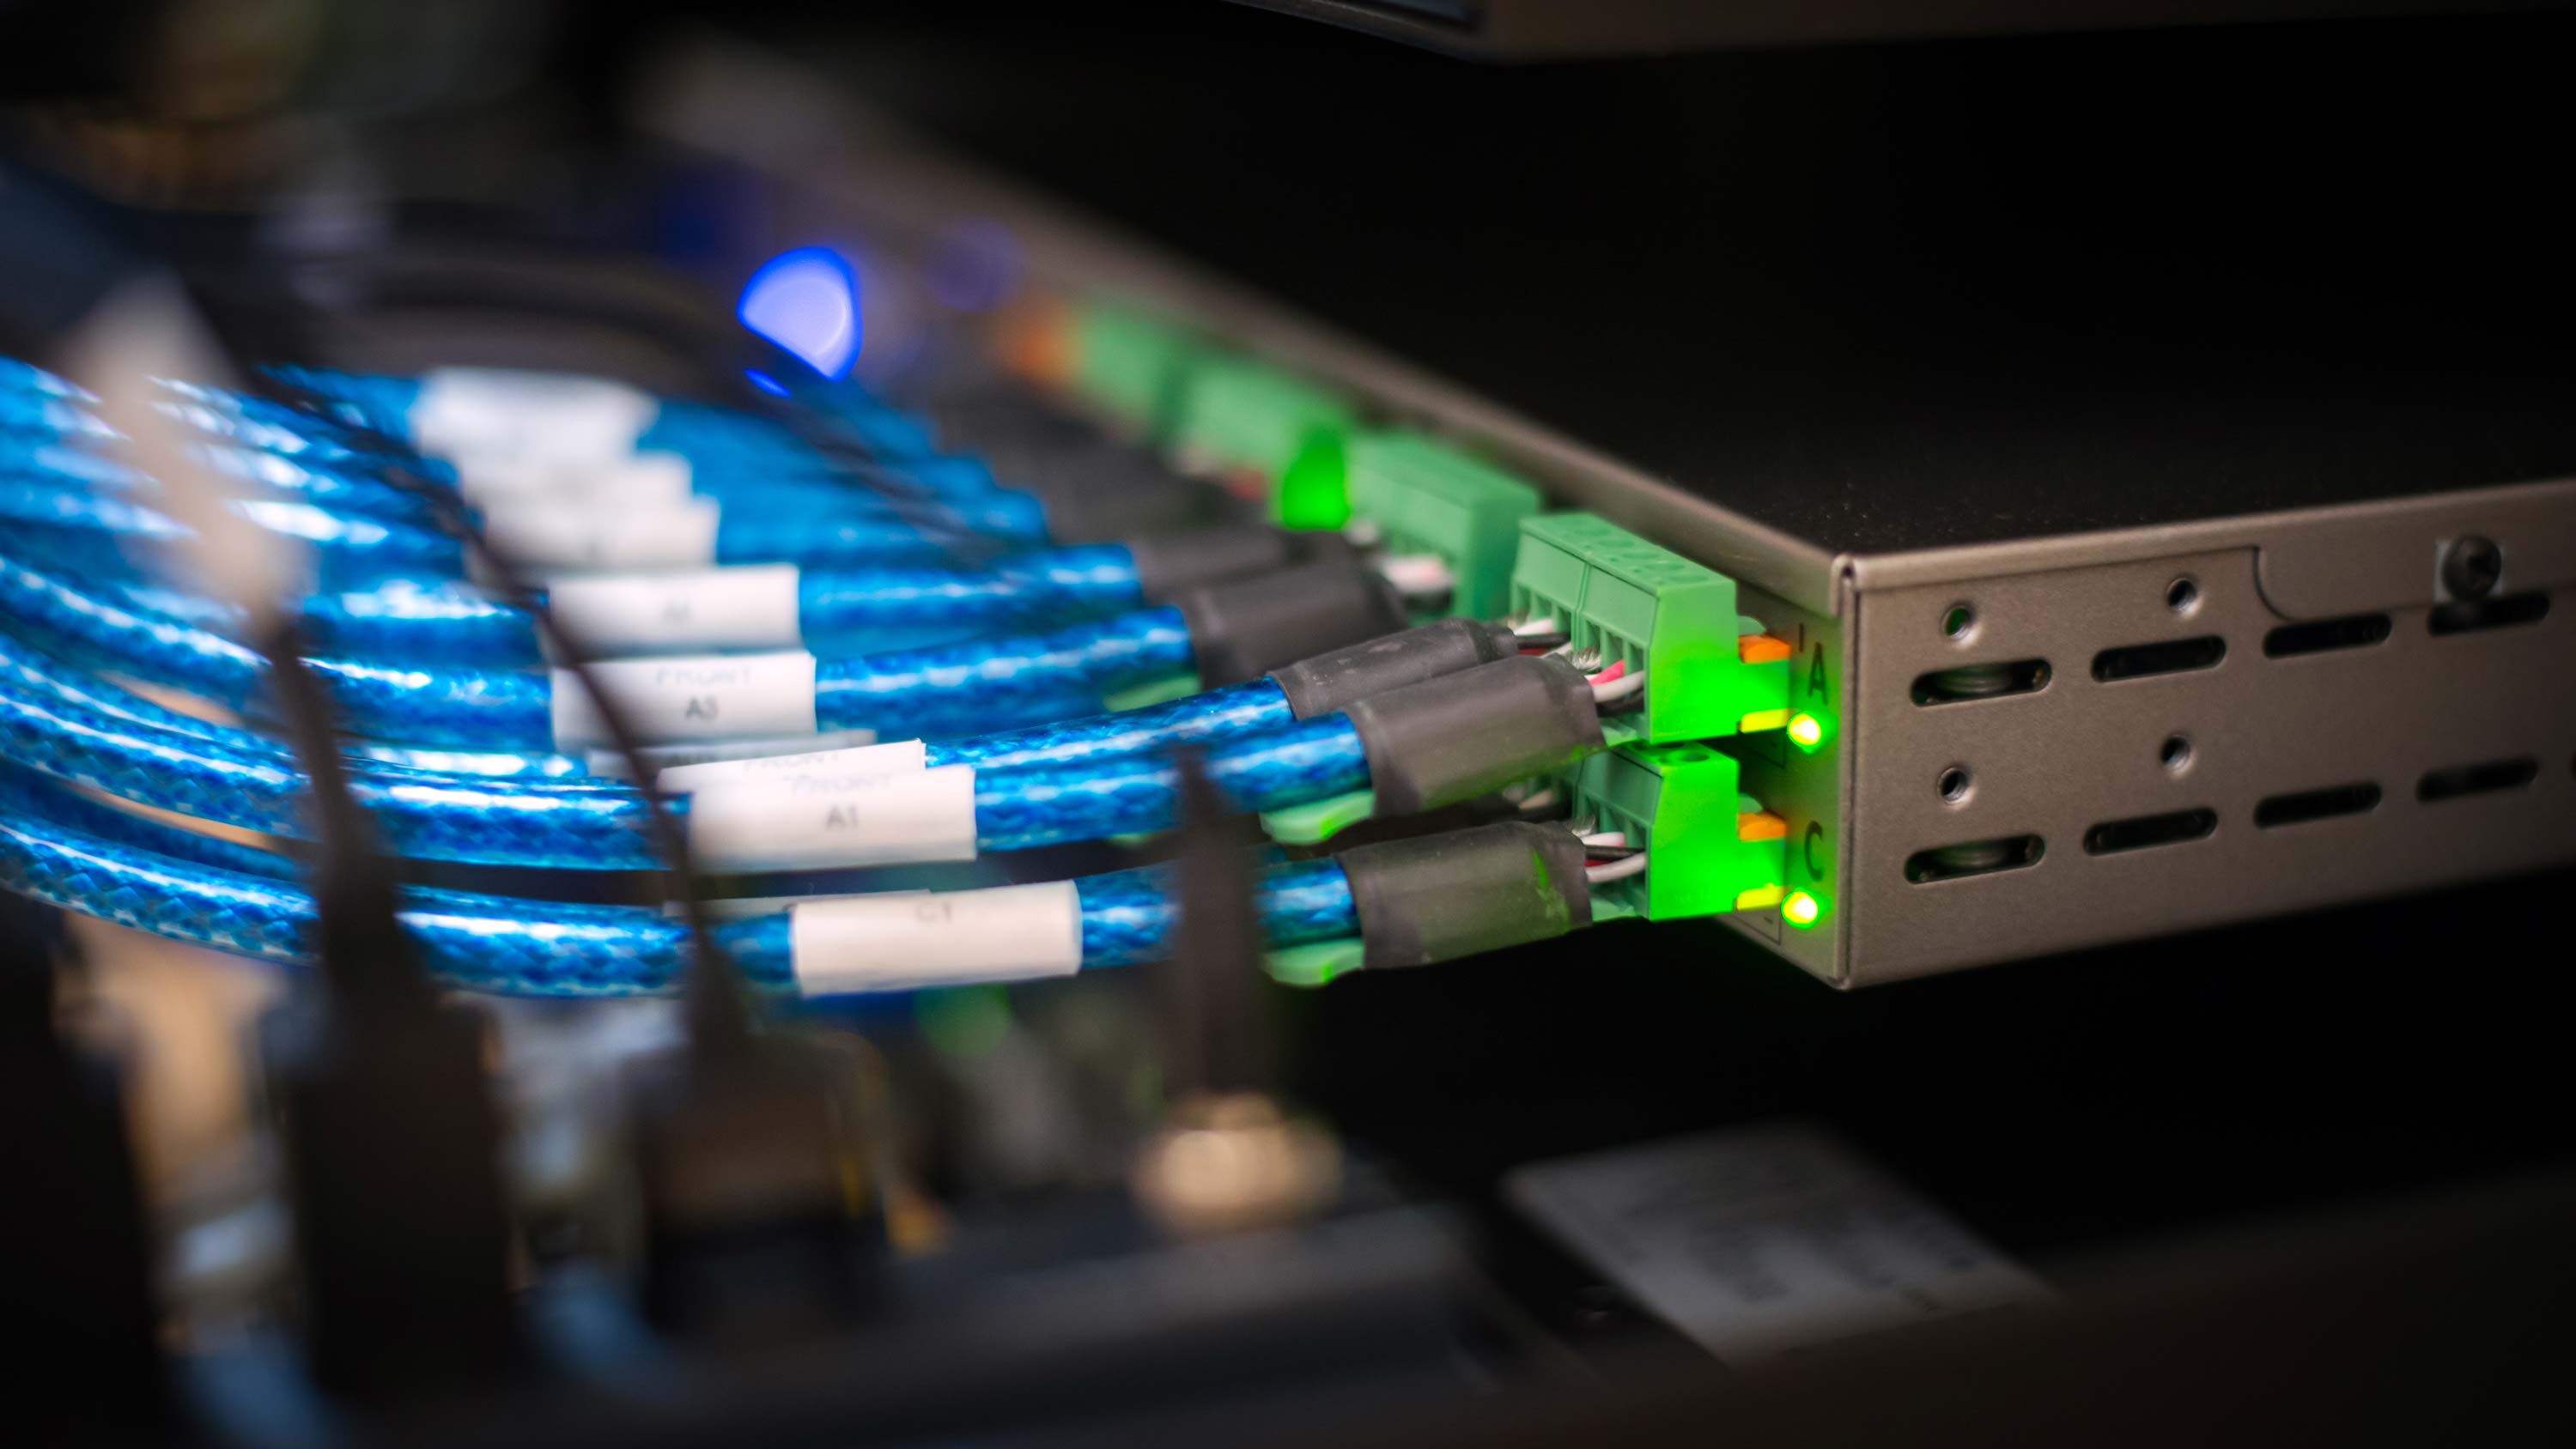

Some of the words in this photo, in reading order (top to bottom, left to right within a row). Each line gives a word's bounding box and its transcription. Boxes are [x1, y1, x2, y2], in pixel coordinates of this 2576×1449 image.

[1807, 641, 1828, 705] A
[823, 803, 858, 829] A1
[1804, 821, 1823, 882] C
